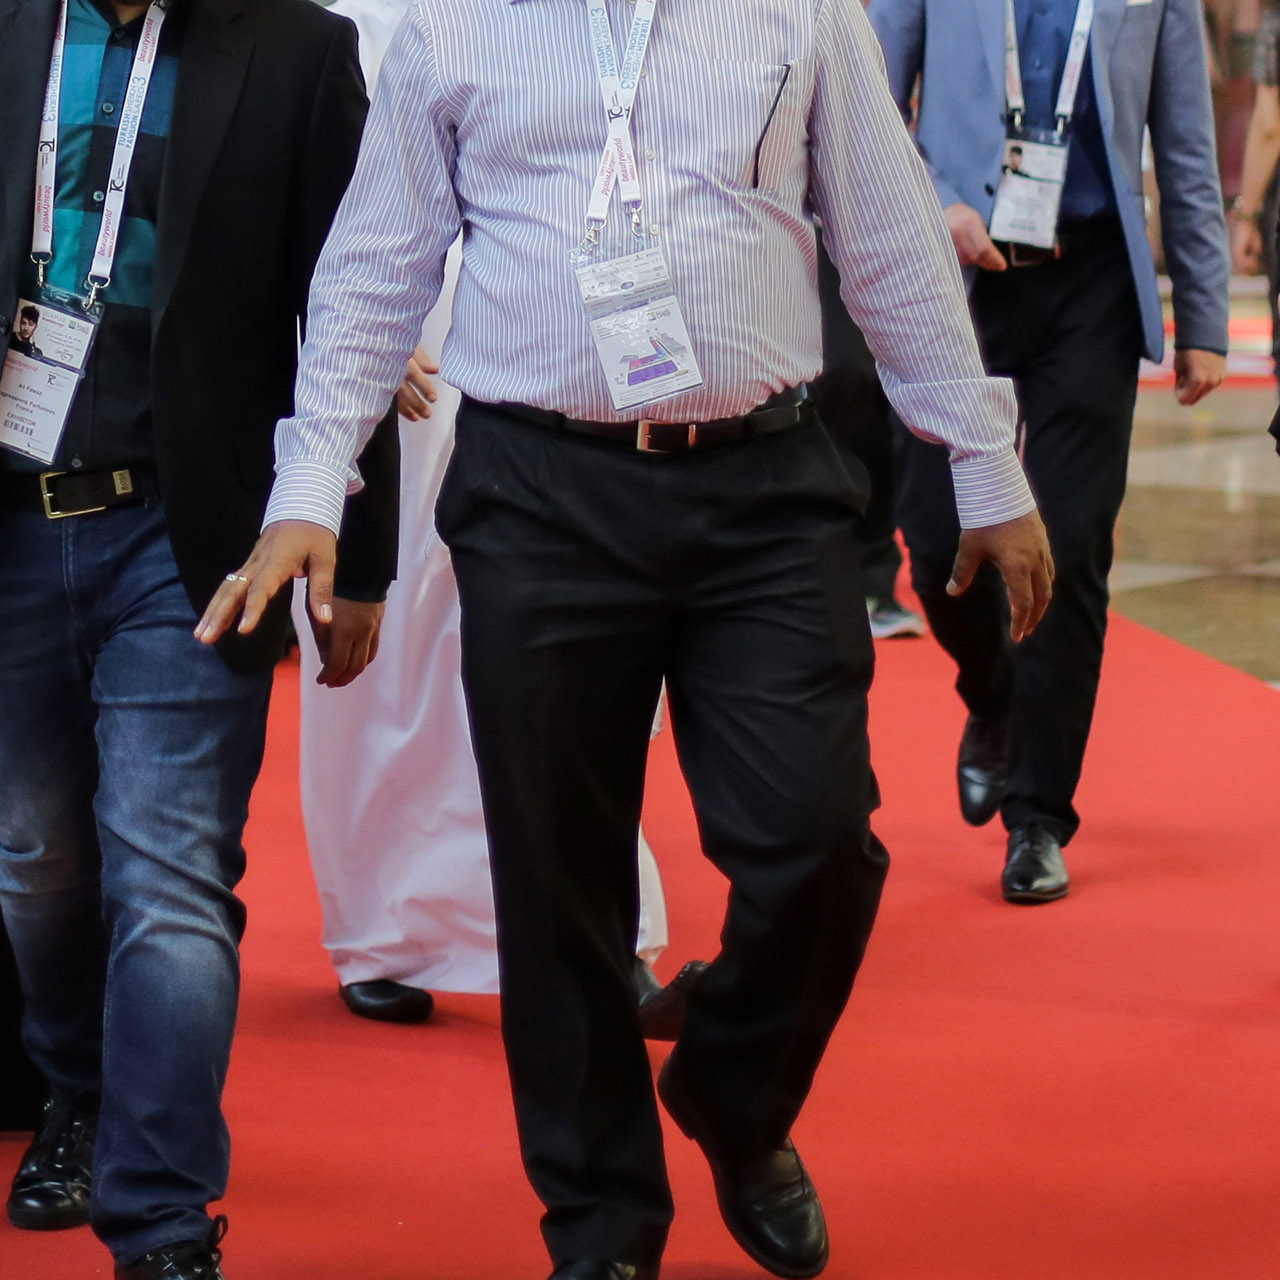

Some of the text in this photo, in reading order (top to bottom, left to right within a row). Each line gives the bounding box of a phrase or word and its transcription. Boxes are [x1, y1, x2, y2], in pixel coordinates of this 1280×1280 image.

[137, 18, 154, 62] beautyworld
[589, 18, 602, 46] SHEIKH
[598, 16, 617, 77] PAVILION SAEED
[621, 16, 642, 78] PAVILION SAEED
[635, 18, 649, 51] TURKISH
[594, 46, 608, 78] TURKISH
[629, 51, 641, 80] SHEIKH
[116, 112, 131, 146] TURKISH
[124, 84, 137, 113] SHEIKH
[124, 86, 144, 148] PAVILION SAEED
[613, 138, 629, 182] beautyworld
[40, 185, 53, 232] beautyworld
[97, 208, 112, 256] beautyworld
